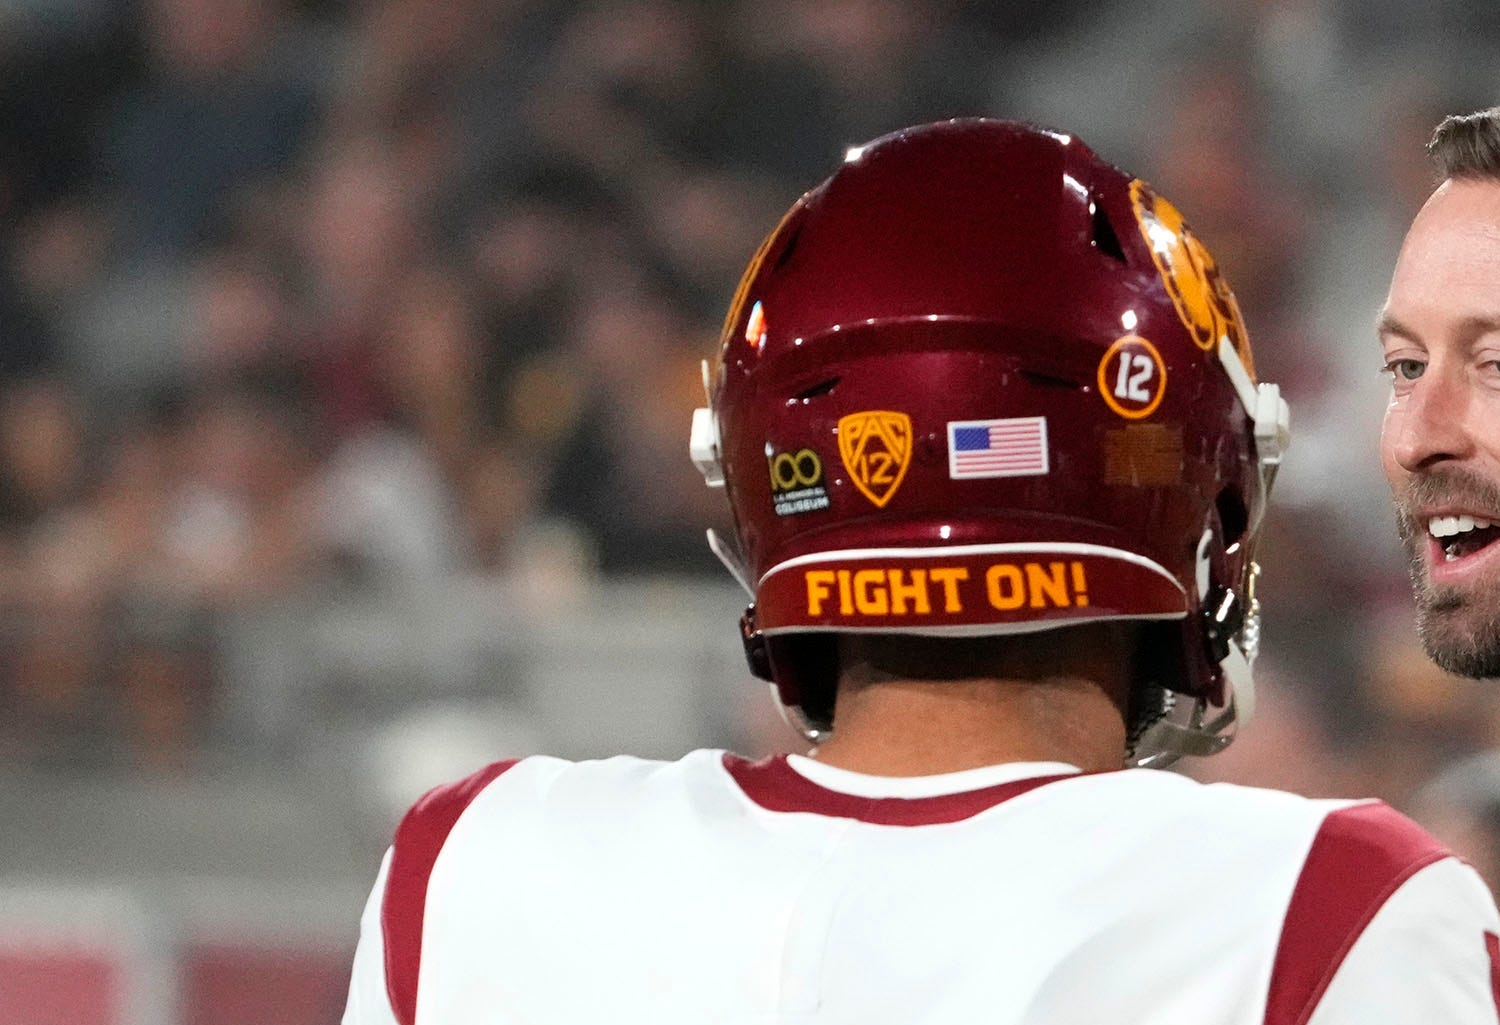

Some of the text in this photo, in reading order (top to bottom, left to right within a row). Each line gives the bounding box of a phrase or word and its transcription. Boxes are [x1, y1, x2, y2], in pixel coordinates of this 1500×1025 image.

[1114, 351, 1154, 403] 12
[842, 416, 905, 466] PAC
[765, 442, 821, 490] 100
[861, 452, 894, 485] 12
[775, 497, 829, 516] COLISEUM
[805, 561, 1089, 616] FIGHT ON!
